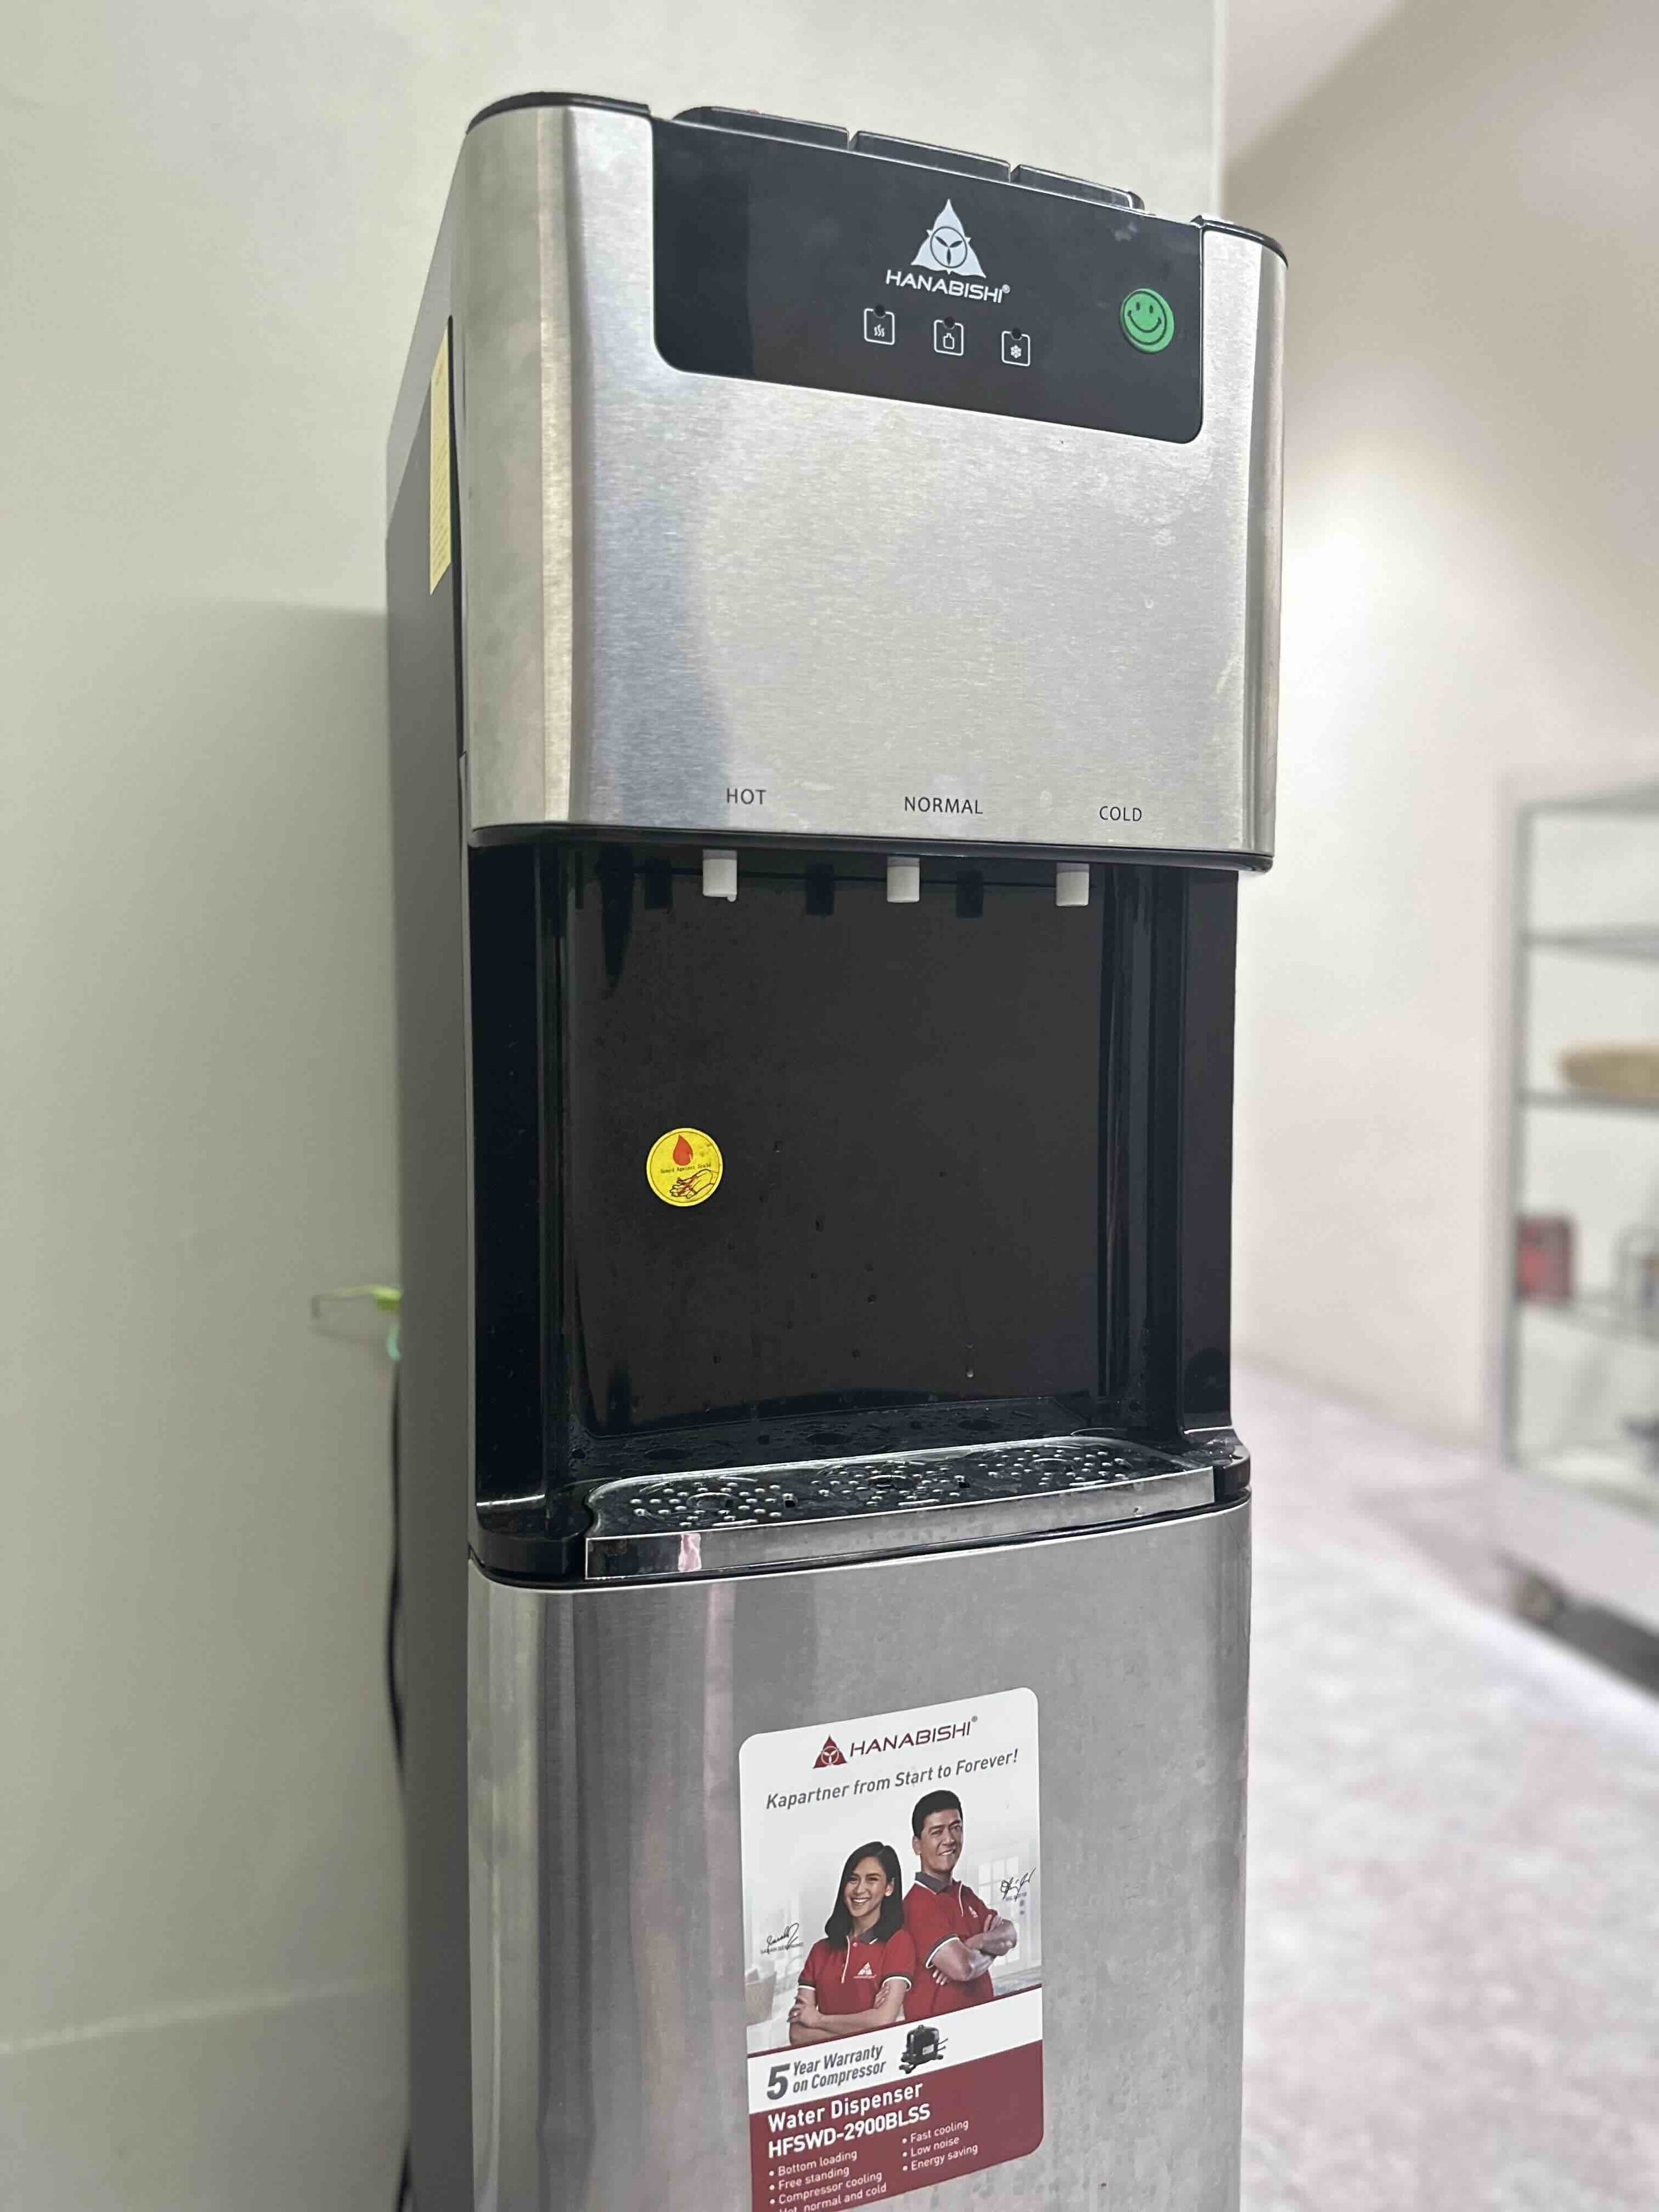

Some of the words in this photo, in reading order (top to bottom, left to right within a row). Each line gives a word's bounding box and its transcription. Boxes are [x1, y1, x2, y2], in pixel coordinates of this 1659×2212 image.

[726, 788, 767, 805] HOT
[904, 796, 983, 815] NORMAL
[1100, 806, 1142, 822] COLD
[766, 1785, 850, 1809] Kapartner
[853, 1779, 891, 1795] from
[895, 1766, 933, 1786] Start
[937, 1764, 952, 1778] to
[956, 1748, 1018, 1775] Forever!
[767, 2063, 791, 2100] 5
[794, 2059, 820, 2076] Year
[824, 2046, 883, 2069] Warranty
[793, 2080, 808, 2093] on
[811, 2061, 887, 2089] Compressor
[768, 2107, 825, 2133] Water
[831, 2083, 923, 2119] Dispenser
[768, 2103, 930, 2158] HFSWD-2900BLSS
[910, 2130, 931, 2143] Fast
[934, 2120, 969, 2137] cooling
[911, 2146, 931, 2157] Low
[933, 2137, 960, 2150] noise
[911, 2154, 945, 2171] Energy
[948, 2144, 978, 2160] saving
[778, 2161, 817, 2176] Bottom
[820, 2151, 857, 2166] loading
[779, 2179, 802, 2190] Free
[805, 2166, 850, 2184] standing
[779, 2182, 843, 2205] Compressor
[846, 2172, 882, 2188] cooling
[804, 2195, 842, 2212] normal
[843, 2191, 863, 2203] and
[865, 2181, 887, 2196] cold
